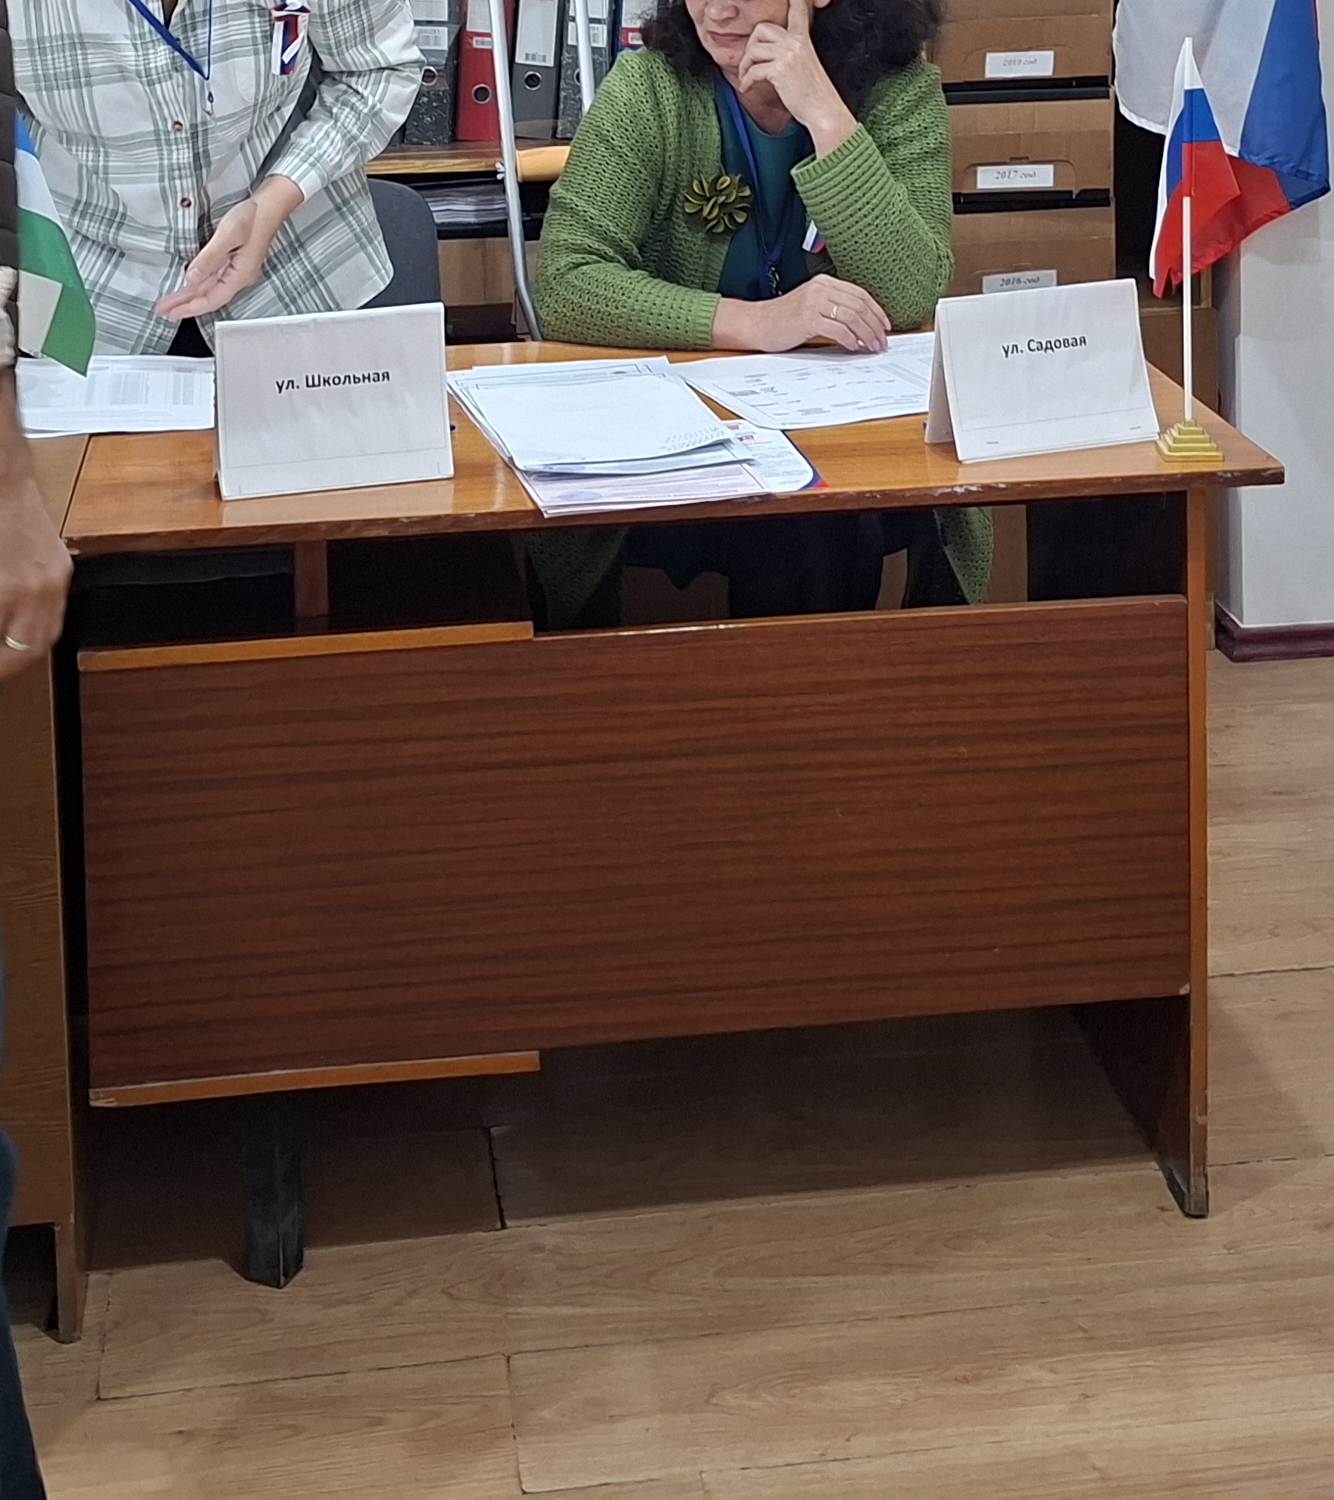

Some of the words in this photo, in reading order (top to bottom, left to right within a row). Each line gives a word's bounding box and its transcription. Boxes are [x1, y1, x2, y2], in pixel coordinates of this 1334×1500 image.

[995, 170, 1019, 180] 2017
[1002, 342, 1024, 358] ул.
[1027, 334, 1087, 354] Садовая
[275, 378, 301, 394] ул.
[305, 370, 391, 389] Школьная
